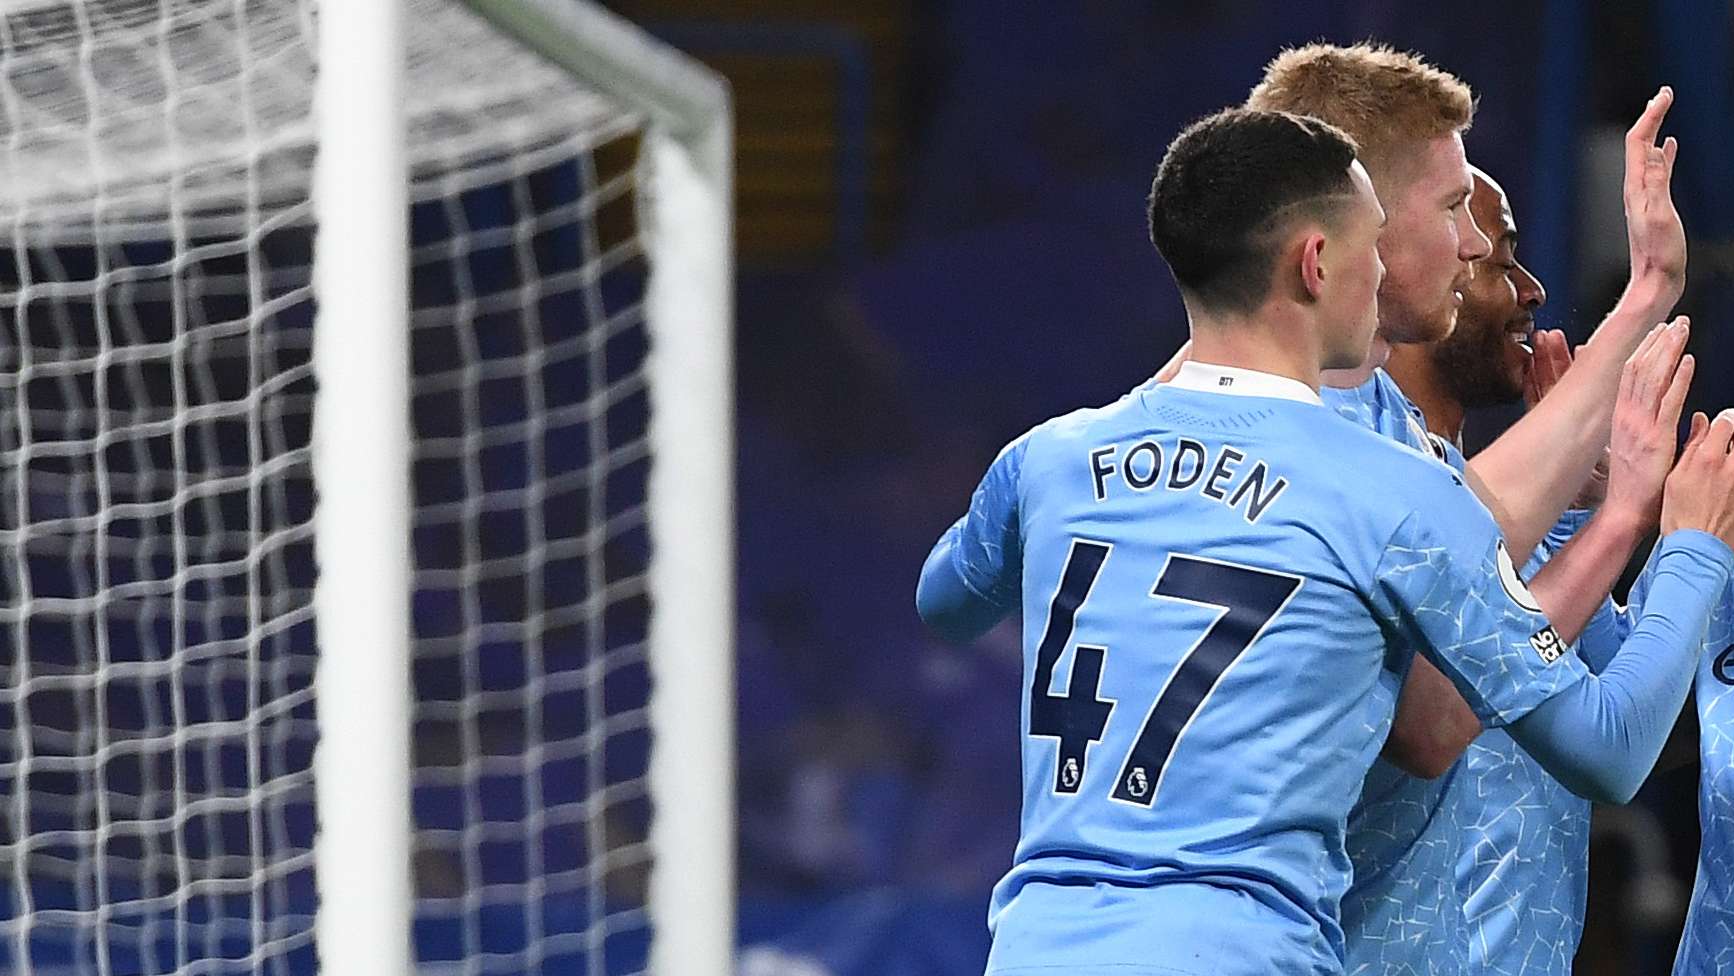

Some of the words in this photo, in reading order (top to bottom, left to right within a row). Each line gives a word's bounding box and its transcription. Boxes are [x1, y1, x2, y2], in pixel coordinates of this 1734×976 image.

[1090, 437, 1287, 523] FODEN
[1028, 538, 1305, 808] 47
[1529, 630, 1554, 654] No
